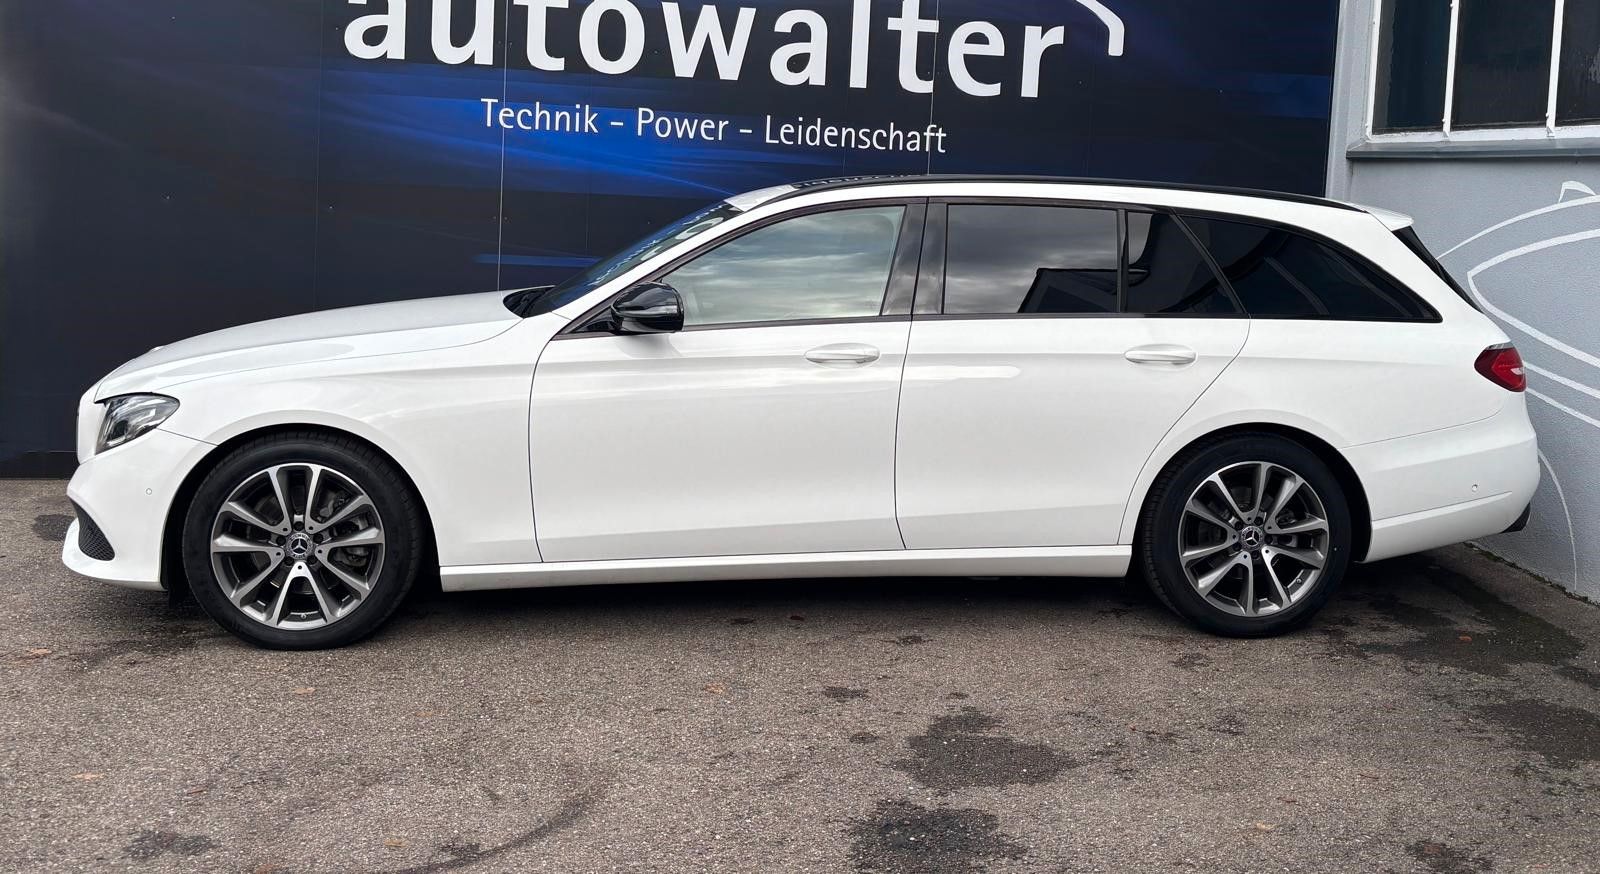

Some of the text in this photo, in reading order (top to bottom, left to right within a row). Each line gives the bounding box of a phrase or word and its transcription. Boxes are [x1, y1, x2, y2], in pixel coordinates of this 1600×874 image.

[344, 0, 1065, 98] autowalter
[481, 98, 599, 134] Technik
[637, 107, 730, 142] Power
[765, 114, 947, 154] Leidenschaft
